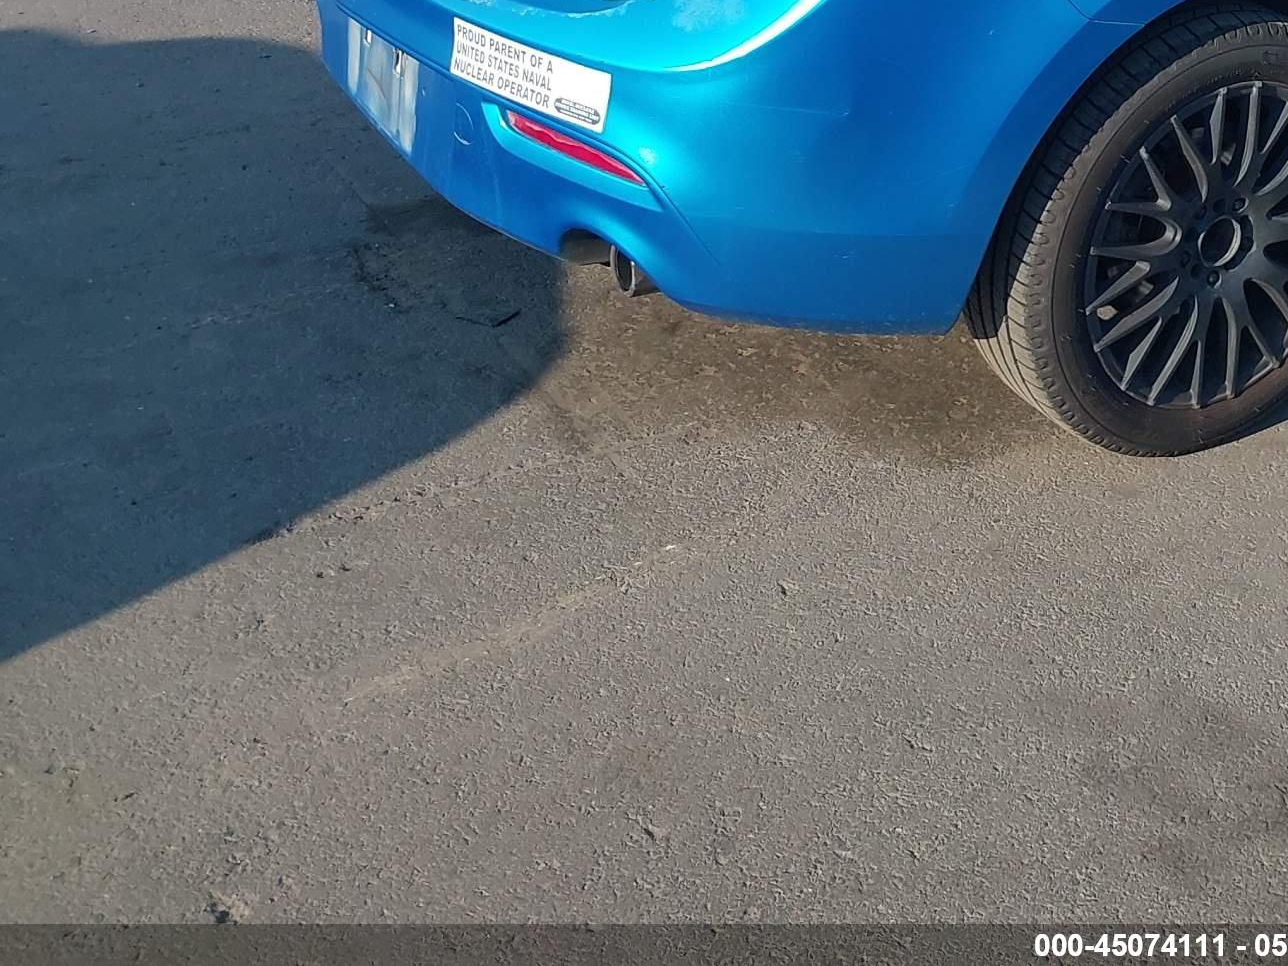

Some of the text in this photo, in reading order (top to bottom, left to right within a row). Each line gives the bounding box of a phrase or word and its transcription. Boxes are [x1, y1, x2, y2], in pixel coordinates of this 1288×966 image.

[456, 40, 551, 91] UNITED STATES NAVAL
[457, 24, 553, 74] PROUD PARENT OF A
[454, 56, 550, 108] NUCLEAR OPERATOR
